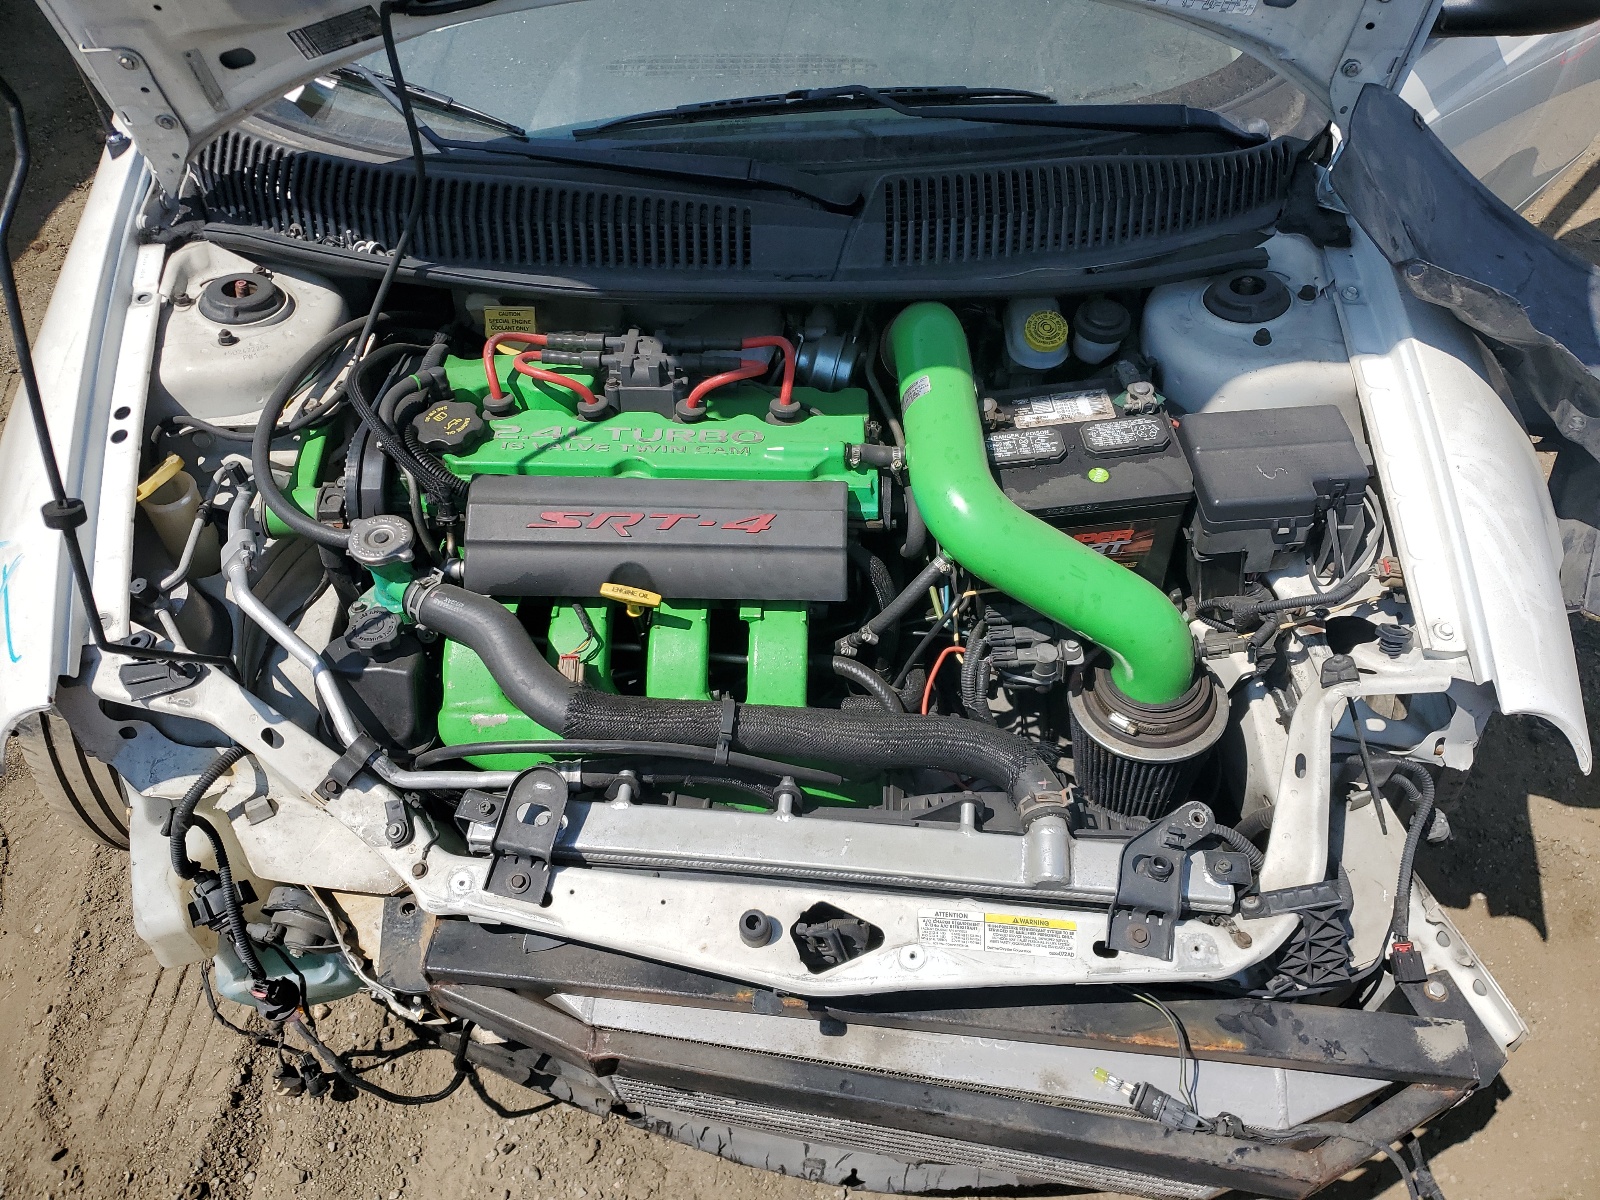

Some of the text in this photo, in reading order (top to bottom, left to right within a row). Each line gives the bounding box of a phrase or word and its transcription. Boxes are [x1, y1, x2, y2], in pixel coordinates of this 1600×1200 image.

[493, 424, 766, 444] 2.4L TURBO
[533, 443, 610, 452] VALVE
[621, 444, 687, 454] TWIN
[695, 446, 751, 456] CAM
[526, 511, 777, 537] SRT-4
[612, 586, 637, 596] ENGINE
[935, 911, 968, 919] ATTENTION
[1019, 918, 1050, 926] WARNING
